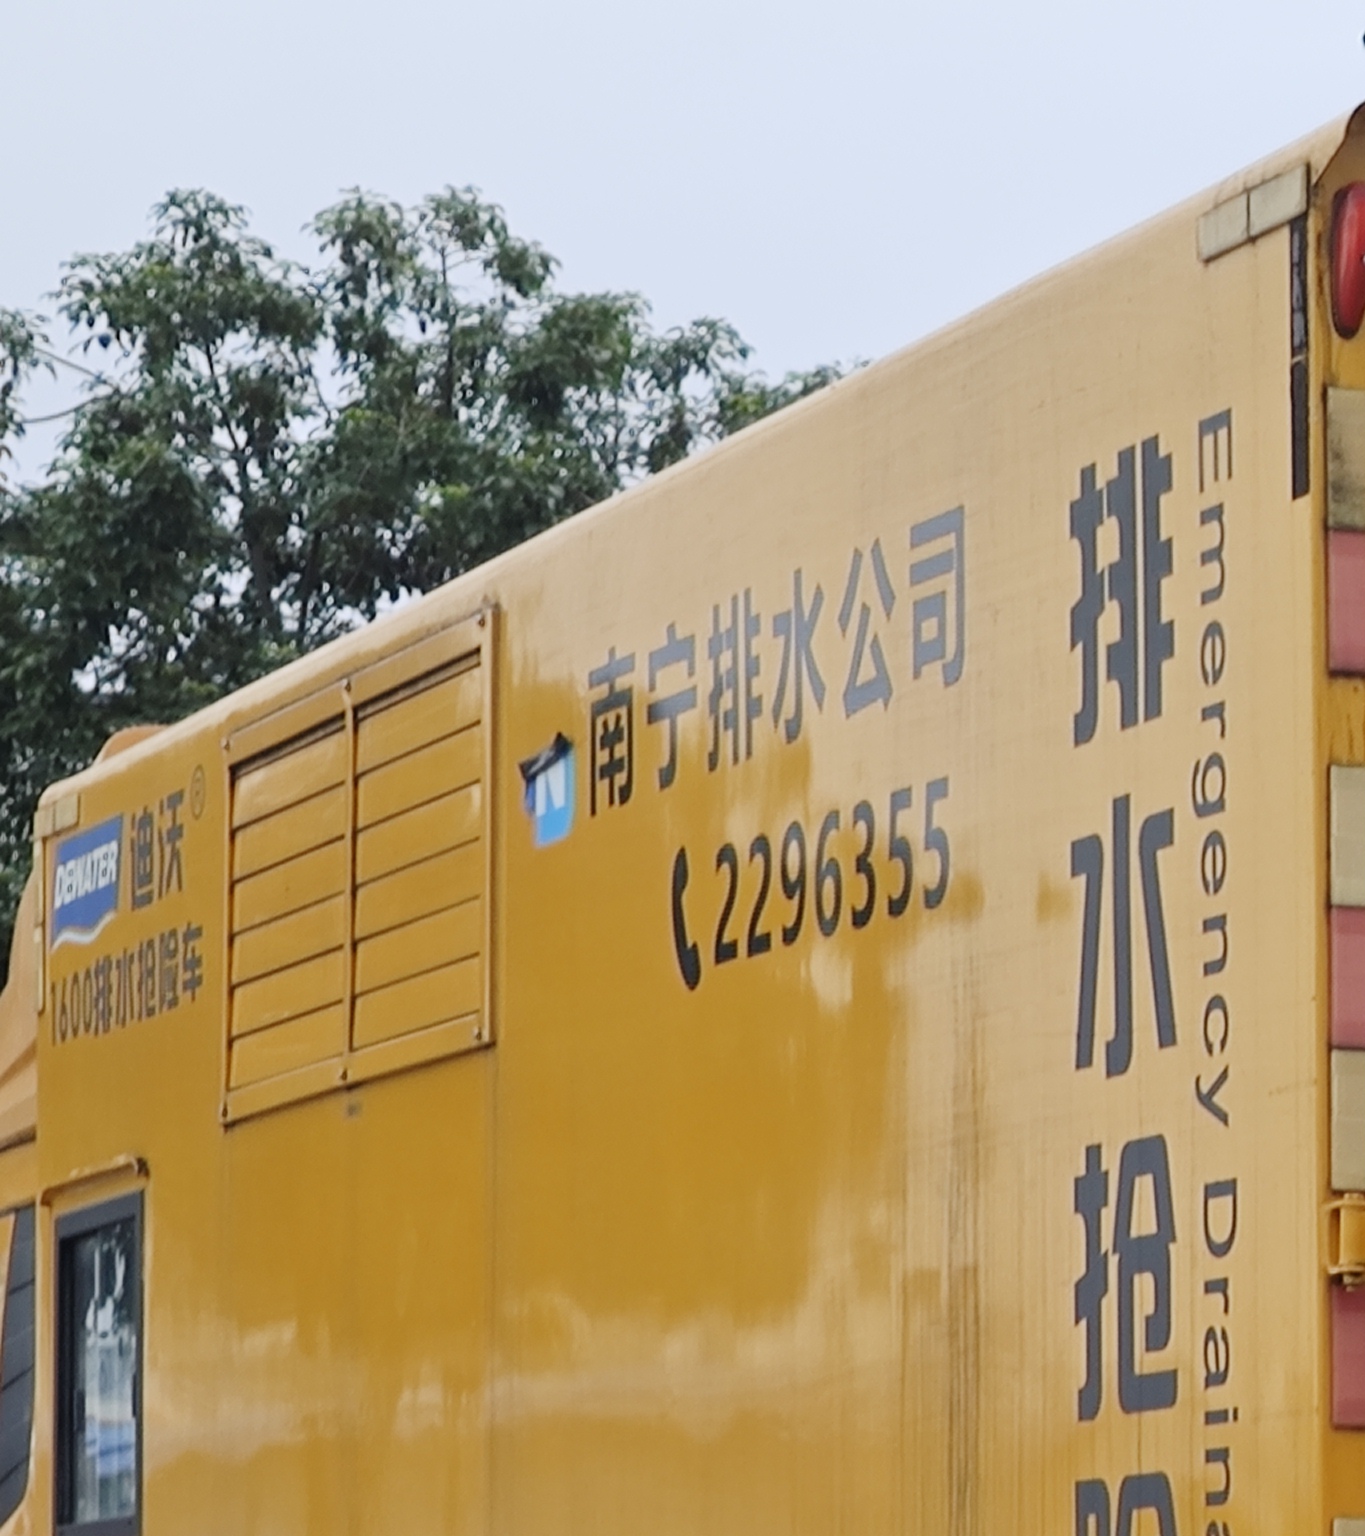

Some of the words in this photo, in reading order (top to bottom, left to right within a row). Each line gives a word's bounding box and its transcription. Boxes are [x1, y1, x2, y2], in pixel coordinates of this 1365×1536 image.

[587, 503, 966, 818] 南宁排水公司
[1190, 407, 1233, 1127] Emergency
[54, 840, 119, 910] DEWATER
[713, 775, 951, 967] 2296355
